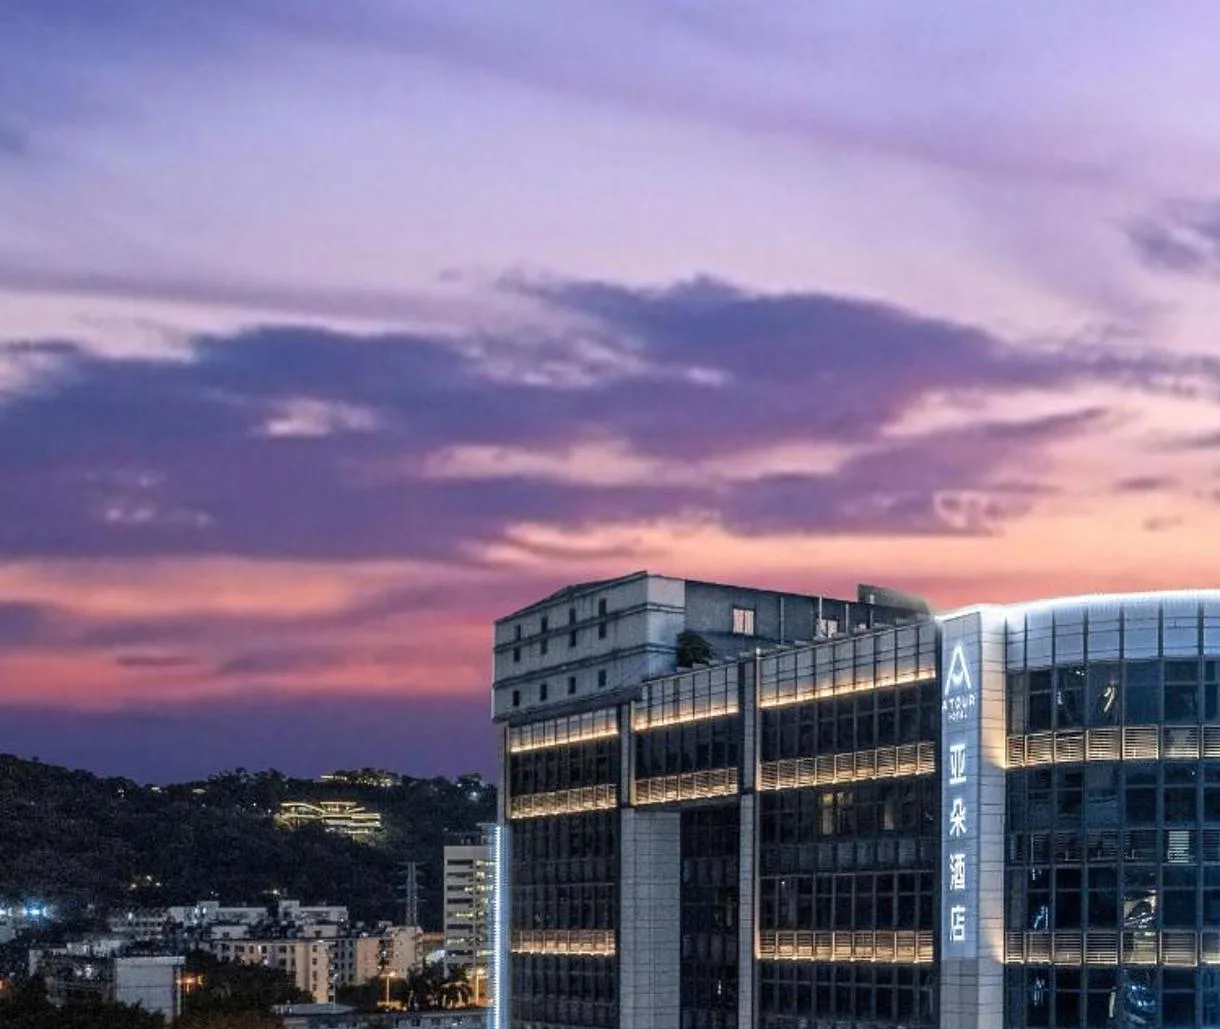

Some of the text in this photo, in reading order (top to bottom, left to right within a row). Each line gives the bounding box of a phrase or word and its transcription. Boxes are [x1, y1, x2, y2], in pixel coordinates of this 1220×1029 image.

[941, 694, 976, 711] ATOUR
[949, 743, 967, 943] 亚朵酒店
